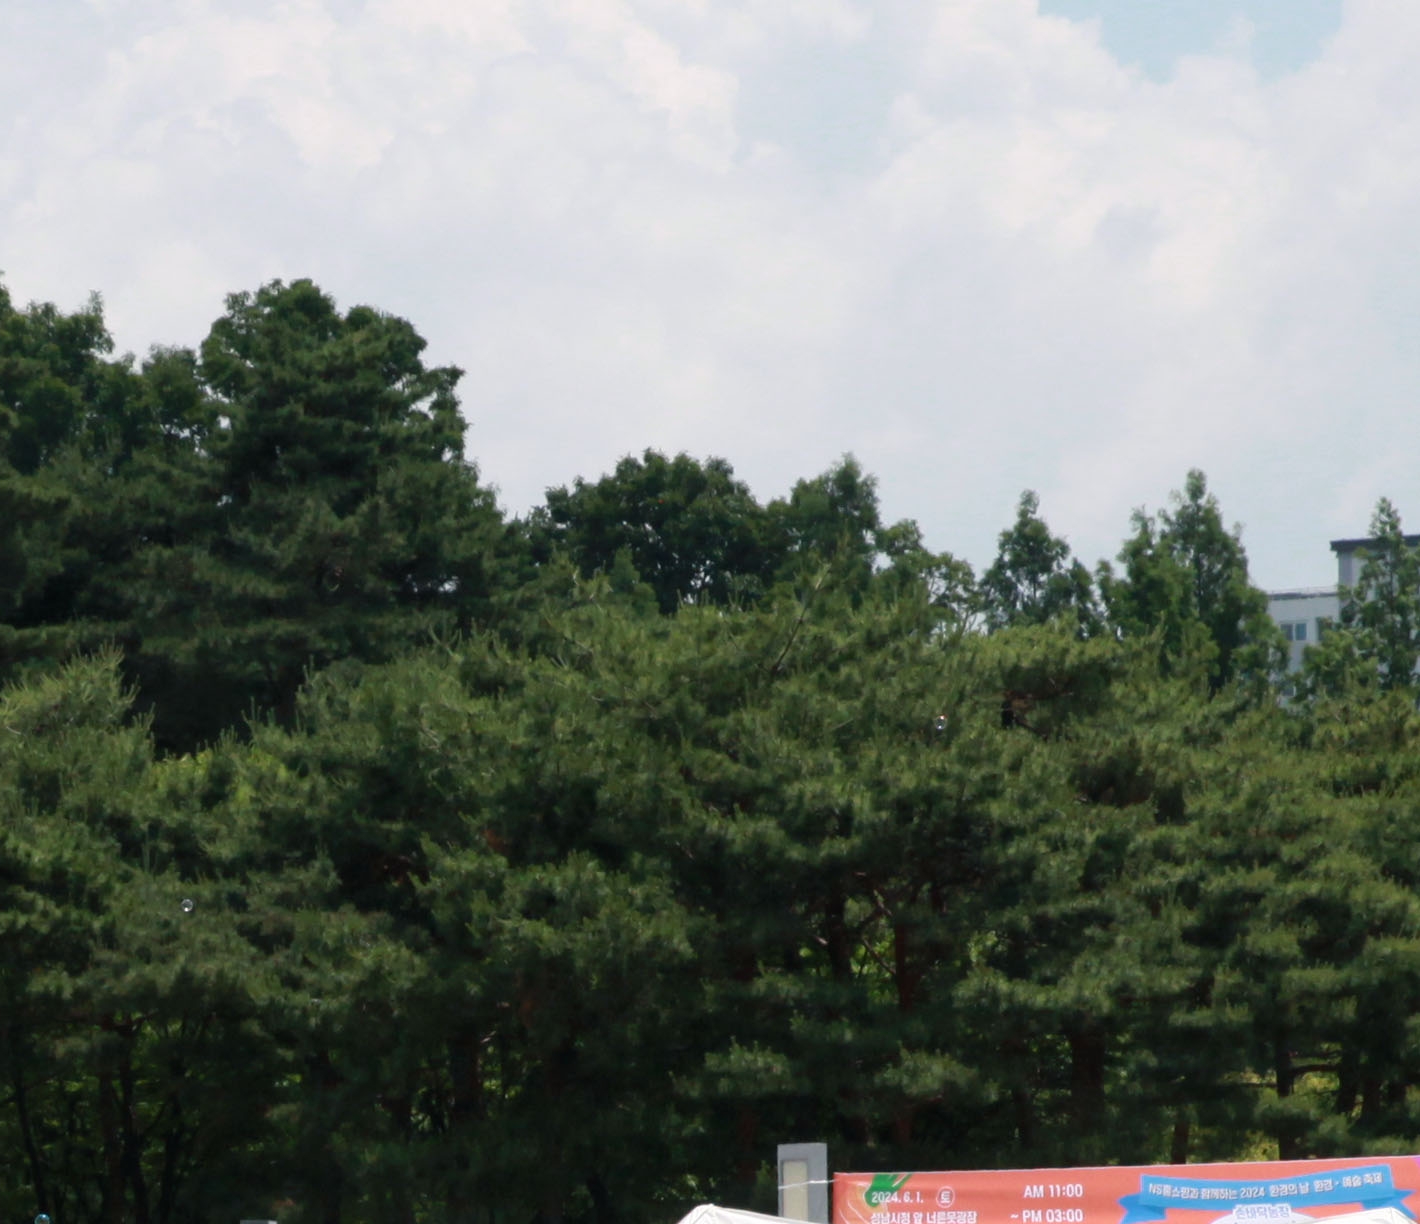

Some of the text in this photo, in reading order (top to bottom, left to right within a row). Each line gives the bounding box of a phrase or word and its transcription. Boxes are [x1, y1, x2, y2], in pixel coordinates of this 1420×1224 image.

[1023, 1184, 1083, 1198] AM 11:00
[1240, 1186, 1265, 1199] 2024
[1022, 1210, 1042, 1223] PM
[1045, 1209, 1083, 1223] 03:00
